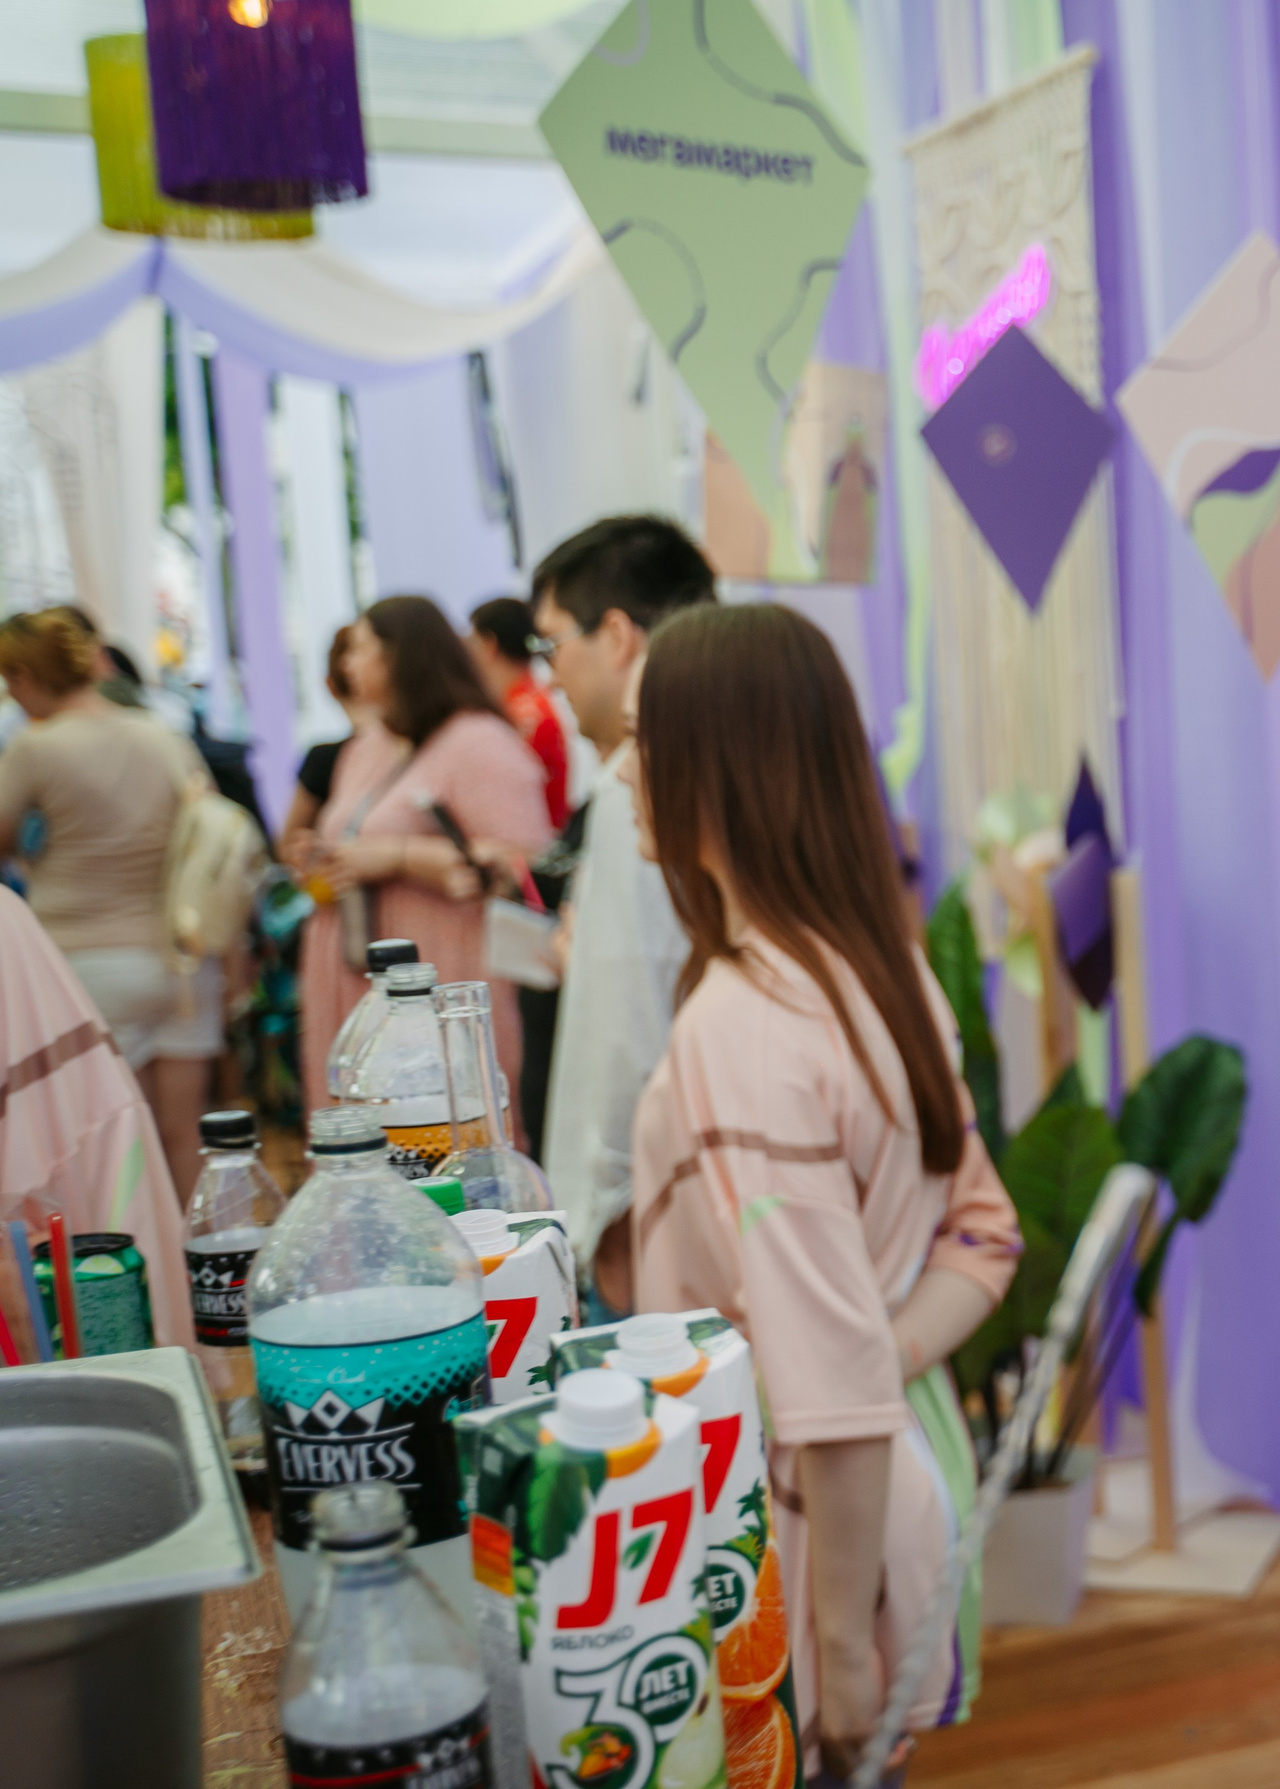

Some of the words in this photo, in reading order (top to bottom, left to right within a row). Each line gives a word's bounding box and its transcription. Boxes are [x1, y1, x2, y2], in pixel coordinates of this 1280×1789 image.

[604, 124, 815, 187] мегамаркет
[276, 1435, 416, 1483] EVERVESS
[556, 1486, 695, 1630] J7
[551, 1625, 635, 1650] ЯБЛОКО
[640, 1659, 692, 1699] ЛЕТ
